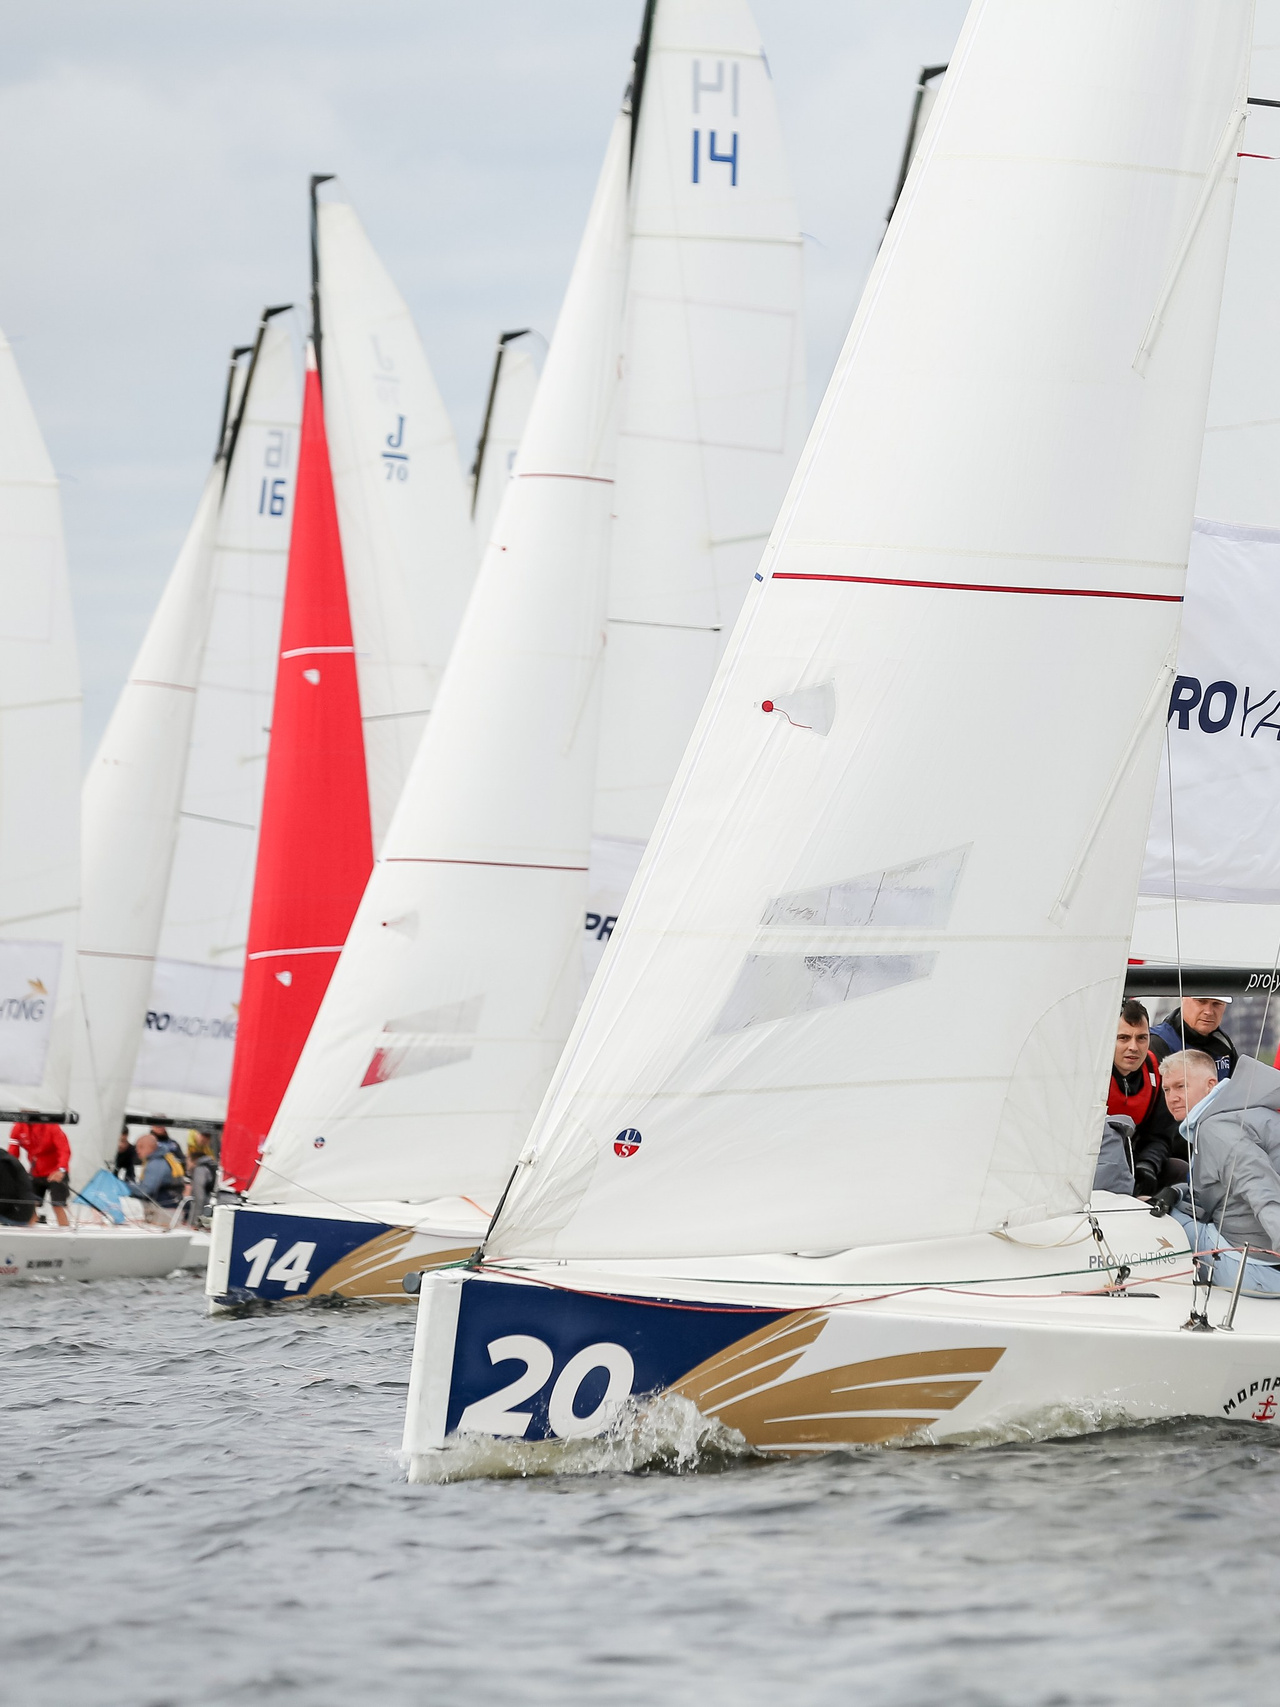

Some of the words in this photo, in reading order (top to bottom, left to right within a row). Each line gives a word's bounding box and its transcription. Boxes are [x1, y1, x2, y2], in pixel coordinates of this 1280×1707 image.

[692, 129, 737, 186] 14
[386, 414, 405, 448] J
[259, 476, 286, 516] 16
[243, 1238, 317, 1292] 14
[456, 1334, 634, 1440] 20
